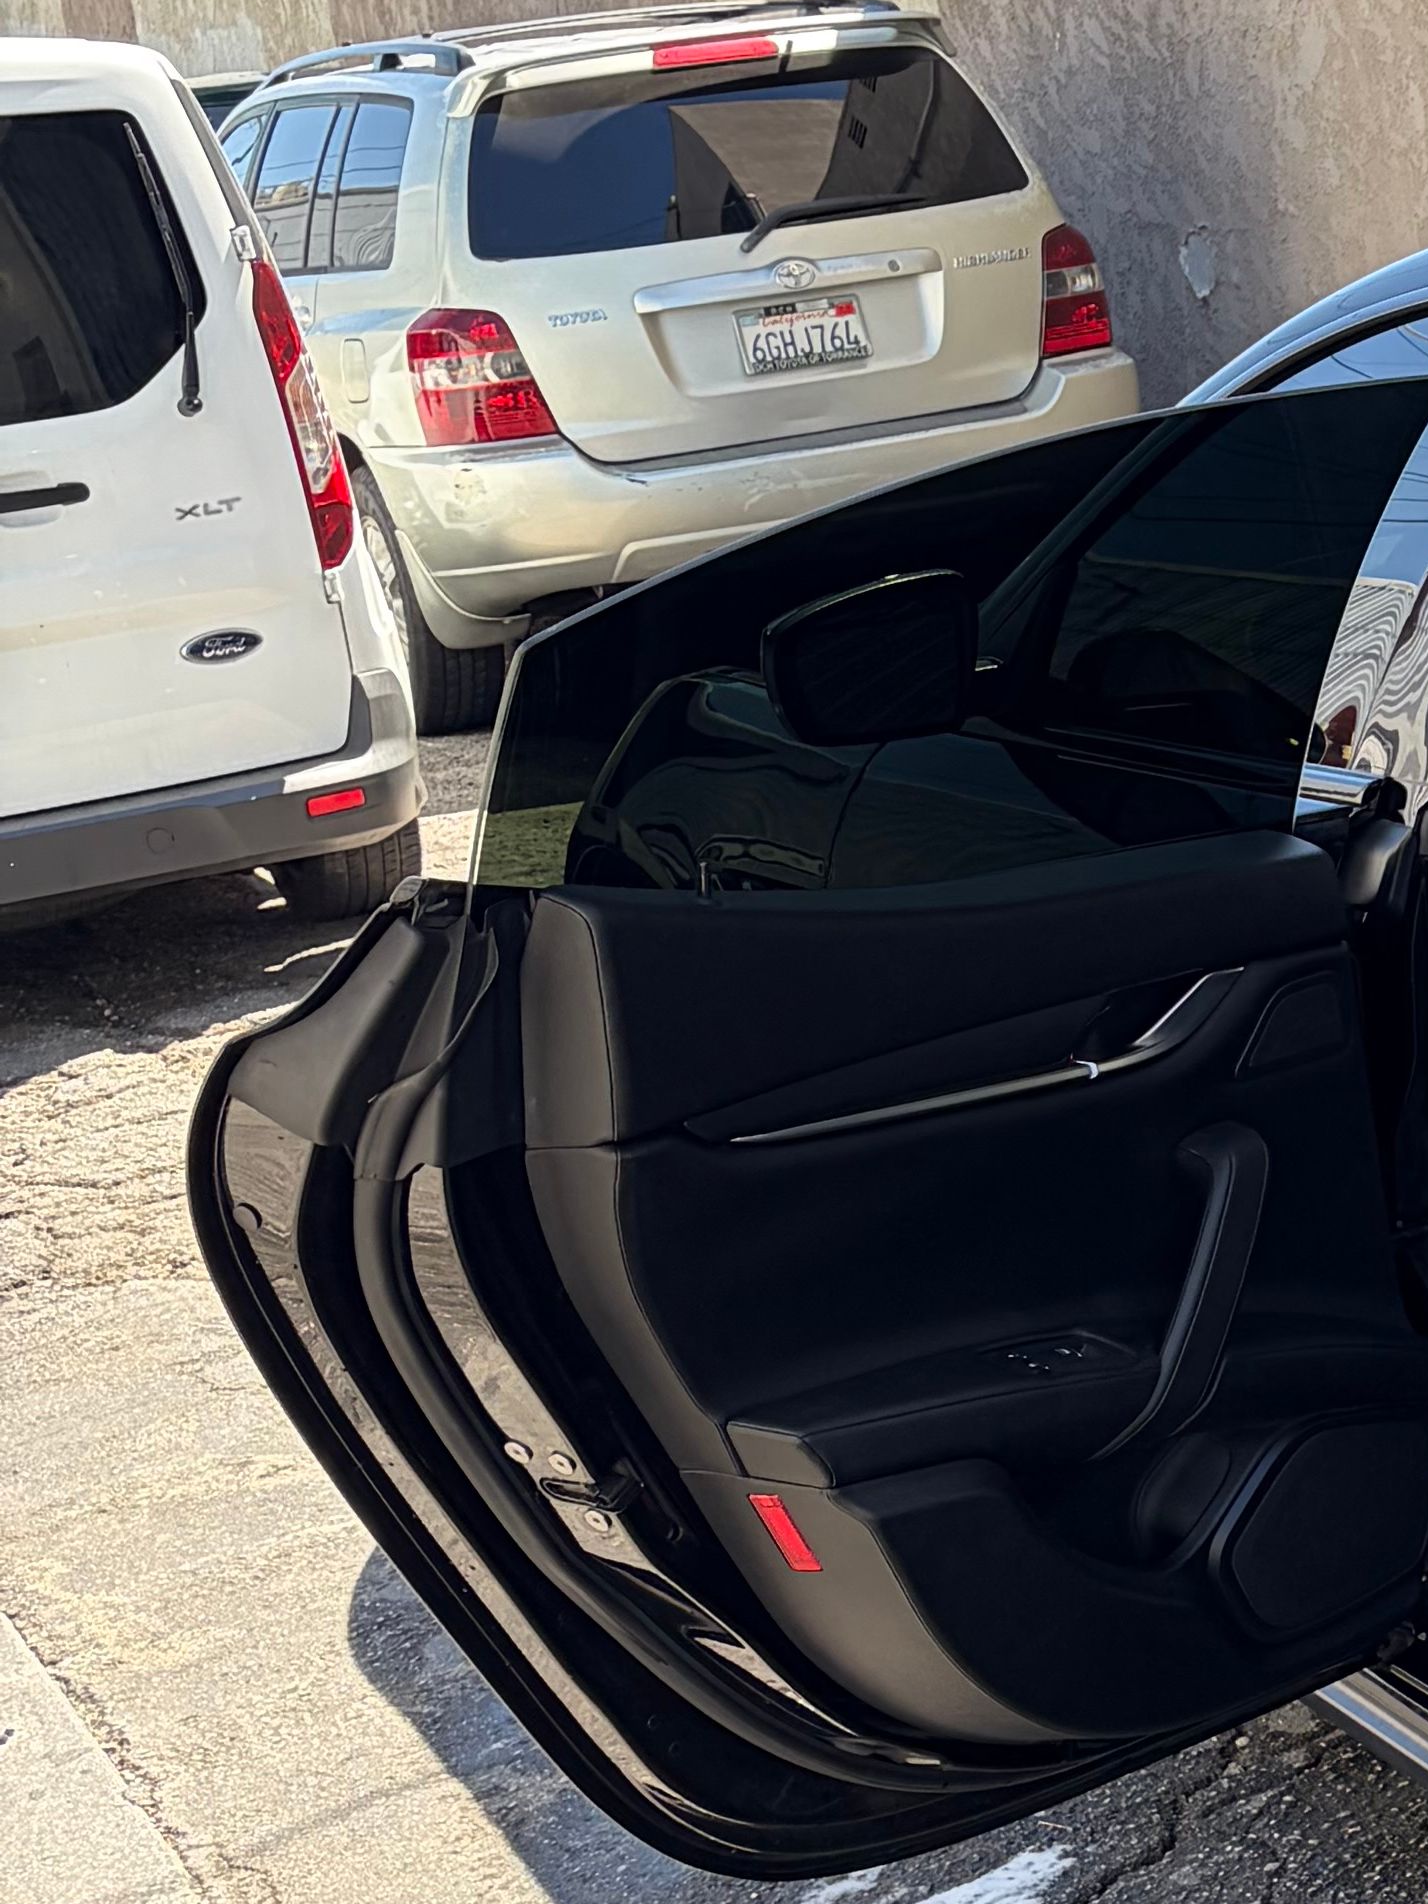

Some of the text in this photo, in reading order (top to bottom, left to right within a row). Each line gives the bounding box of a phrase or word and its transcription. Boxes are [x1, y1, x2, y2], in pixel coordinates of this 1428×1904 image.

[547, 308, 608, 328] TOYOTA
[752, 320, 861, 364] 6GHJ764
[175, 496, 242, 521] XLT
[201, 635, 247, 658] Ford
